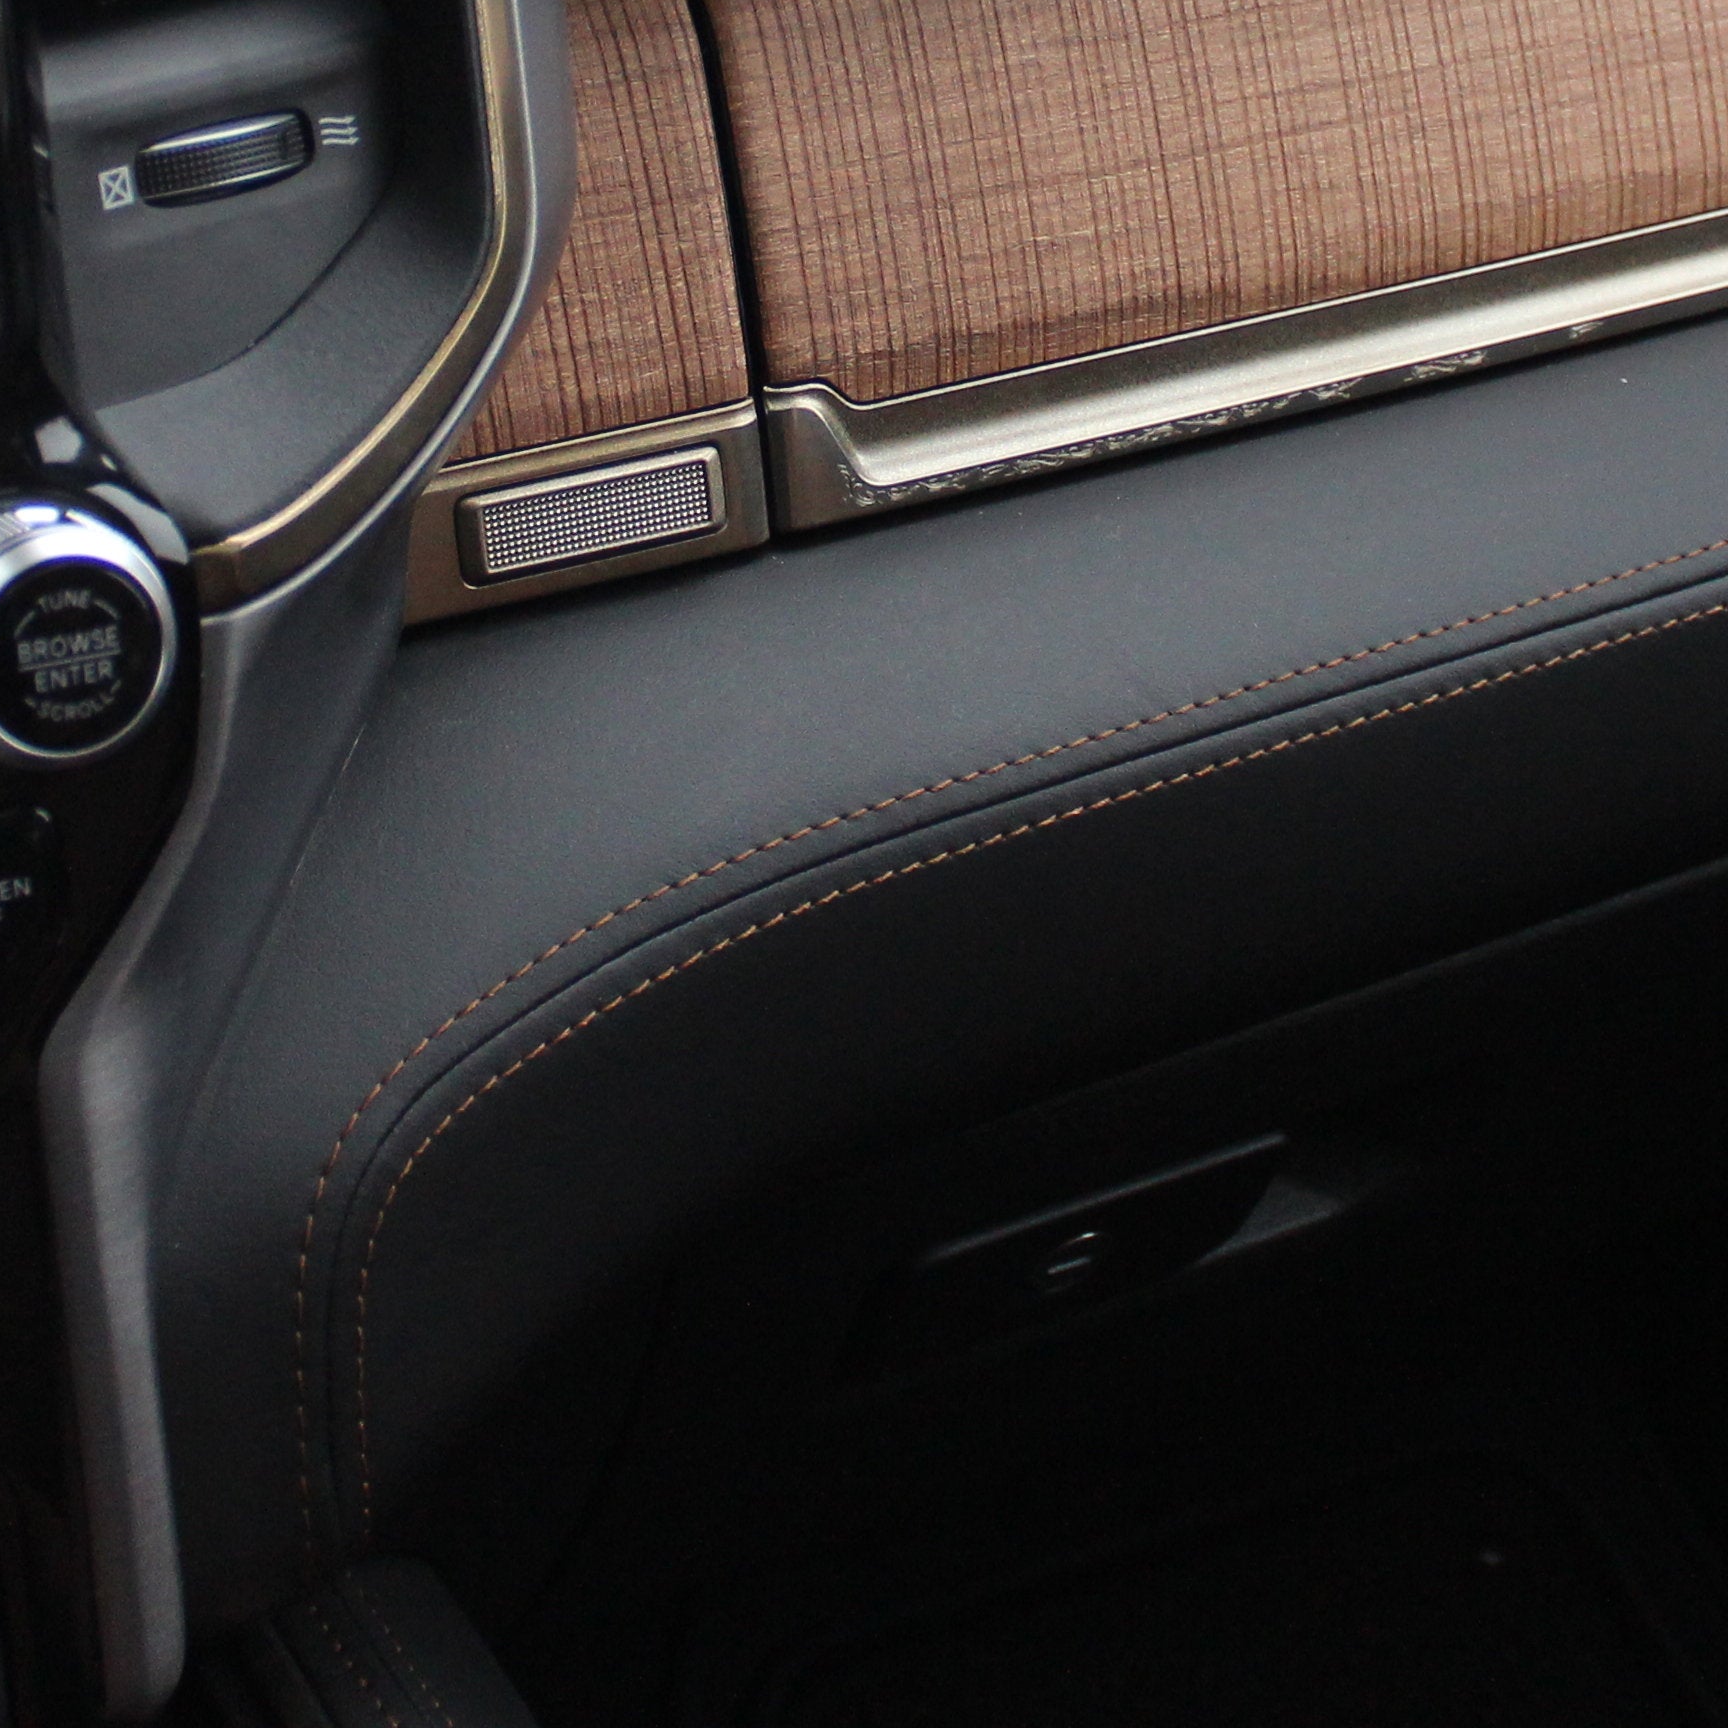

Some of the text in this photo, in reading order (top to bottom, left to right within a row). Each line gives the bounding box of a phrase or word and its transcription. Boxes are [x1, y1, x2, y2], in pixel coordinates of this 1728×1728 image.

[38, 589, 92, 613] TUNE
[17, 625, 118, 664] BROWSE
[34, 660, 114, 693] ENTER
[37, 692, 115, 722] SCROLL
